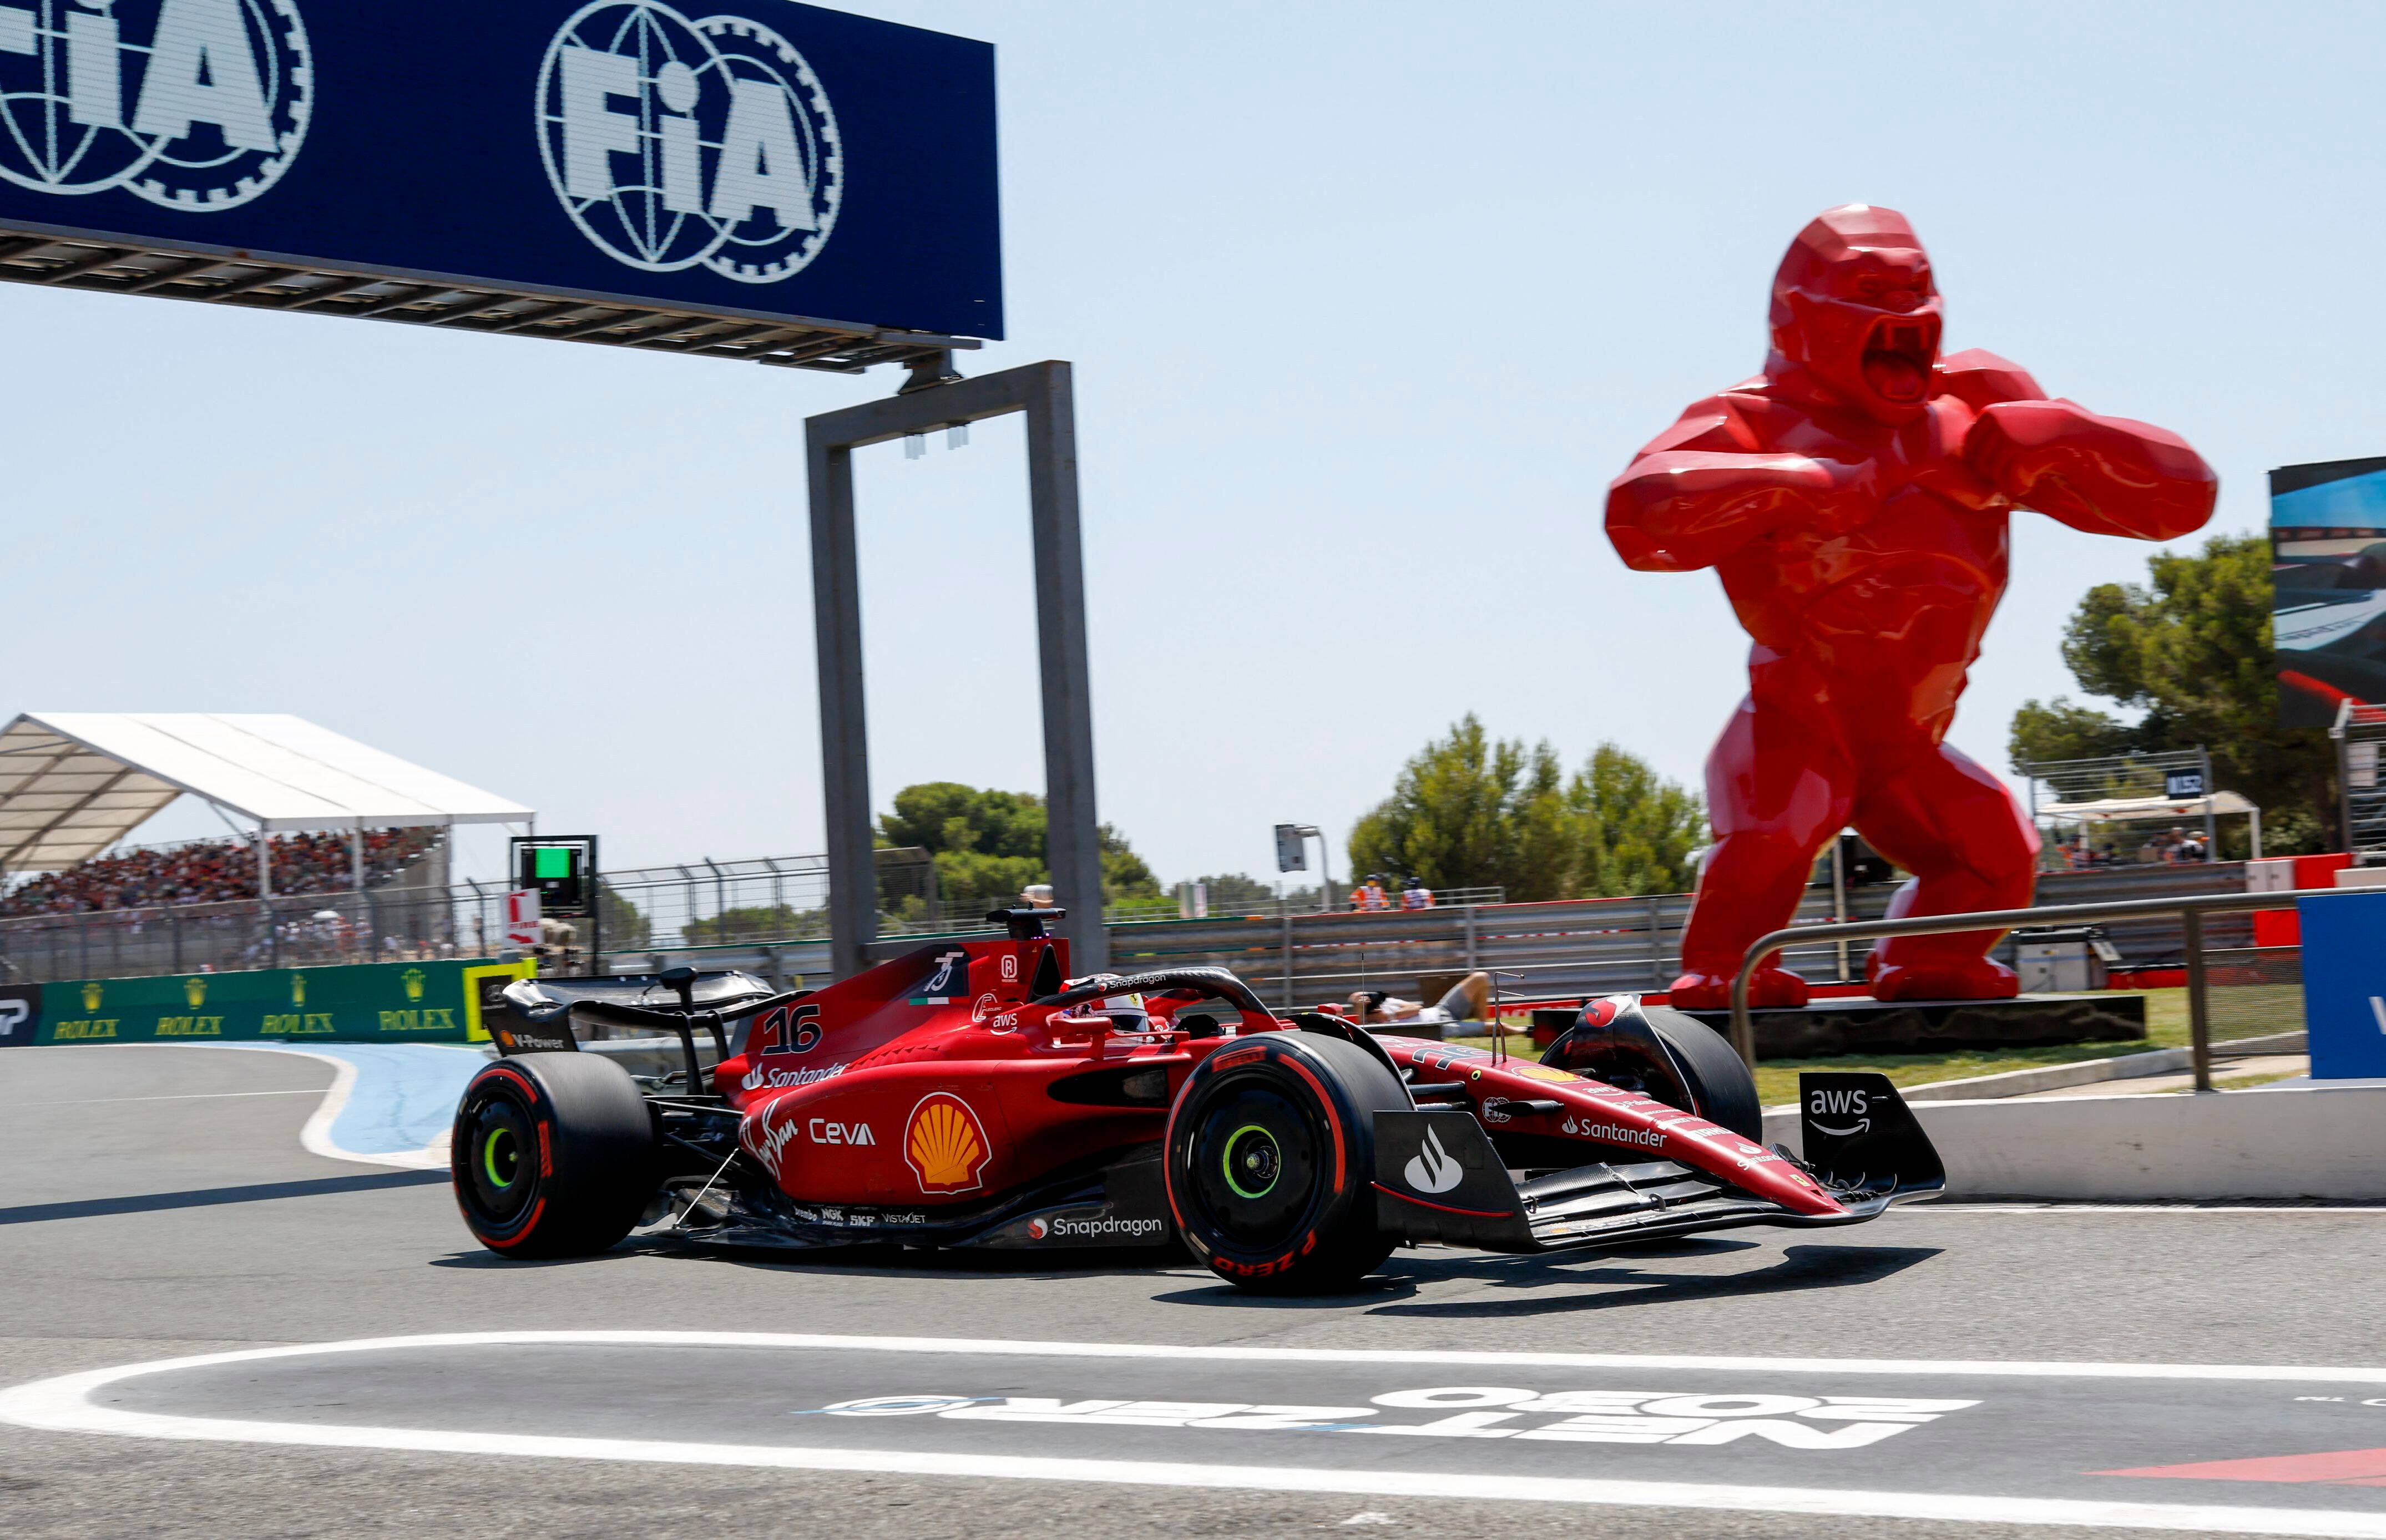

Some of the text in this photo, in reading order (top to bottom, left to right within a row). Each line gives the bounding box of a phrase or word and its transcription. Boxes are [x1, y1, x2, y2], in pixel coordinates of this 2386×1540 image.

[0, 0, 279, 153] iA
[1110, 974, 1166, 988] Snapdragon
[53, 1019, 120, 1039] ROLEX
[154, 1016, 225, 1035] ROLEX
[259, 1014, 336, 1034] ROLEX
[378, 1009, 456, 1030] ROLEX
[760, 1004, 823, 1056] 16
[993, 1012, 1018, 1027] aws
[512, 1034, 564, 1048] V-Power
[1412, 1046, 1503, 1071] 16
[762, 1062, 850, 1088] Santander
[1811, 1090, 1867, 1115] aws
[1581, 1119, 1667, 1147] Santander
[793, 1205, 818, 1221] brembo
[821, 1208, 844, 1221] NGK
[850, 1215, 876, 1227] SKF
[1054, 1215, 1162, 1238] Snapdragon
[1213, 1245, 1296, 1276] ZERO
[1371, 1386, 1985, 1422] 2030
[820, 1394, 1919, 1450] NET ZERO
